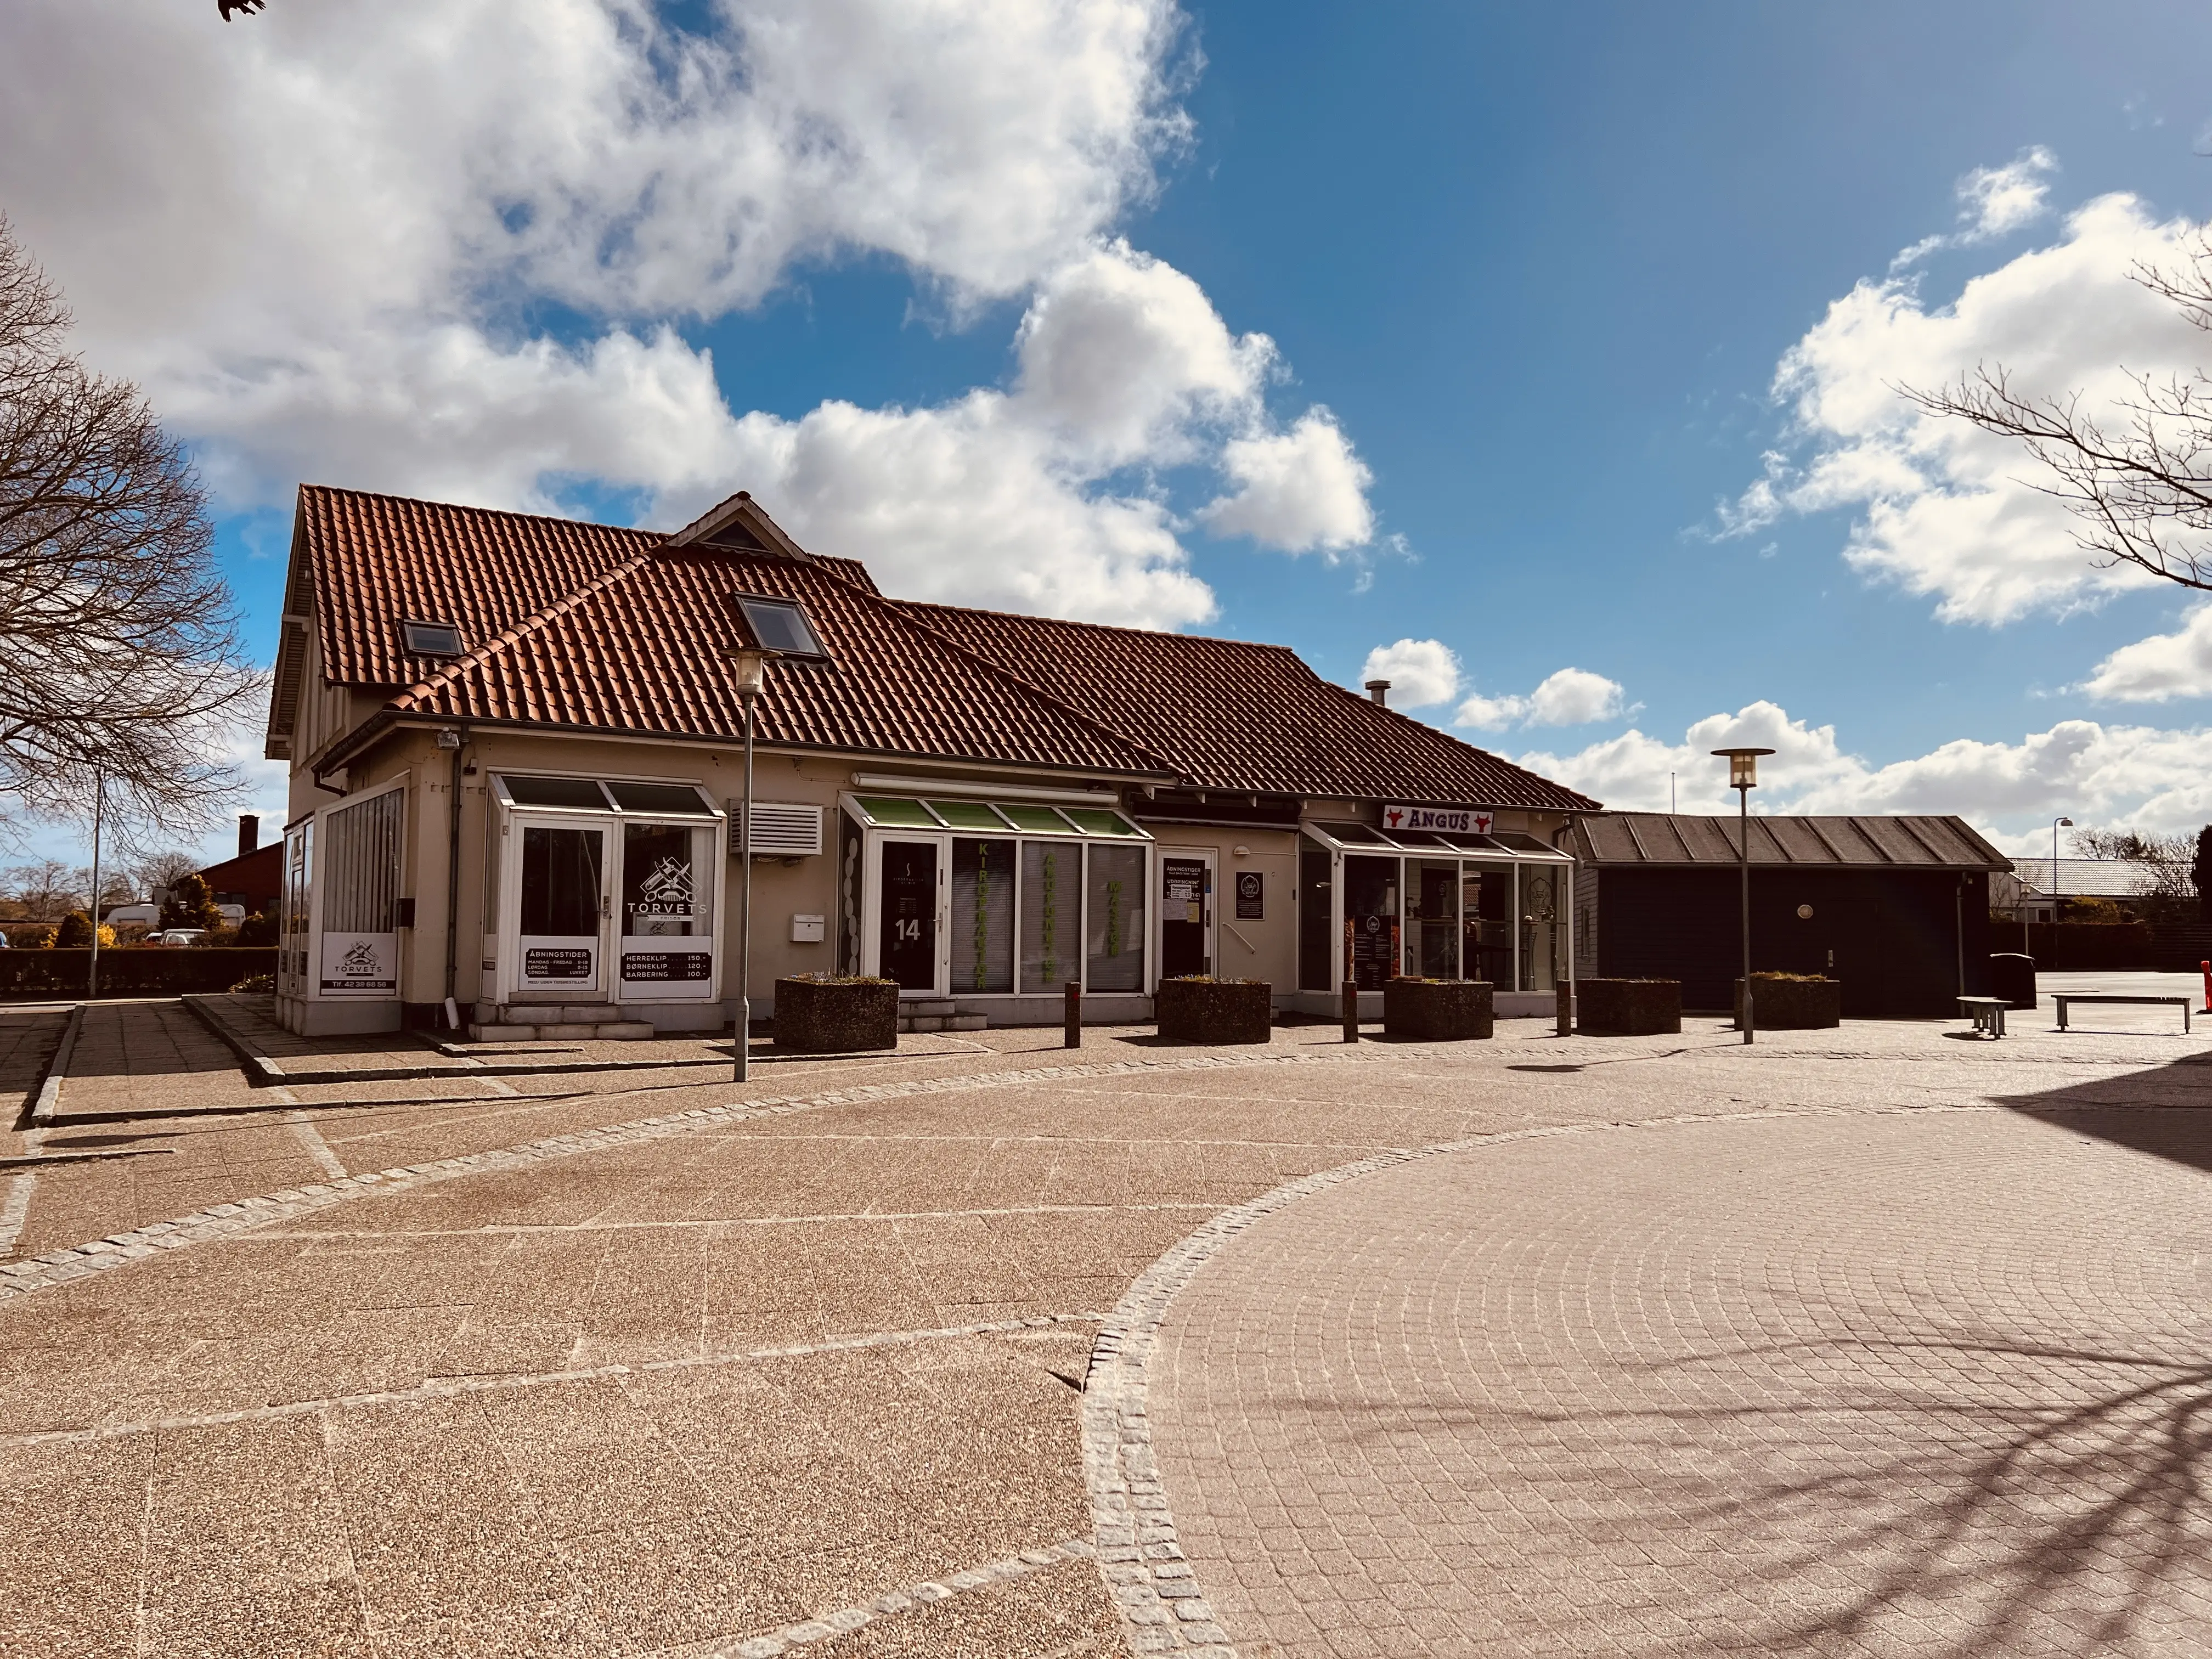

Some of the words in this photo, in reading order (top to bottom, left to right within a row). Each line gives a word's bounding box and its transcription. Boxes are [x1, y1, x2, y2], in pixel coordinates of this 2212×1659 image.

[1408, 809, 1470, 831] ANGUS
[628, 903, 707, 914] TORVETS
[977, 843, 988, 989] KIROPRAKTOR
[895, 919, 921, 940] 14
